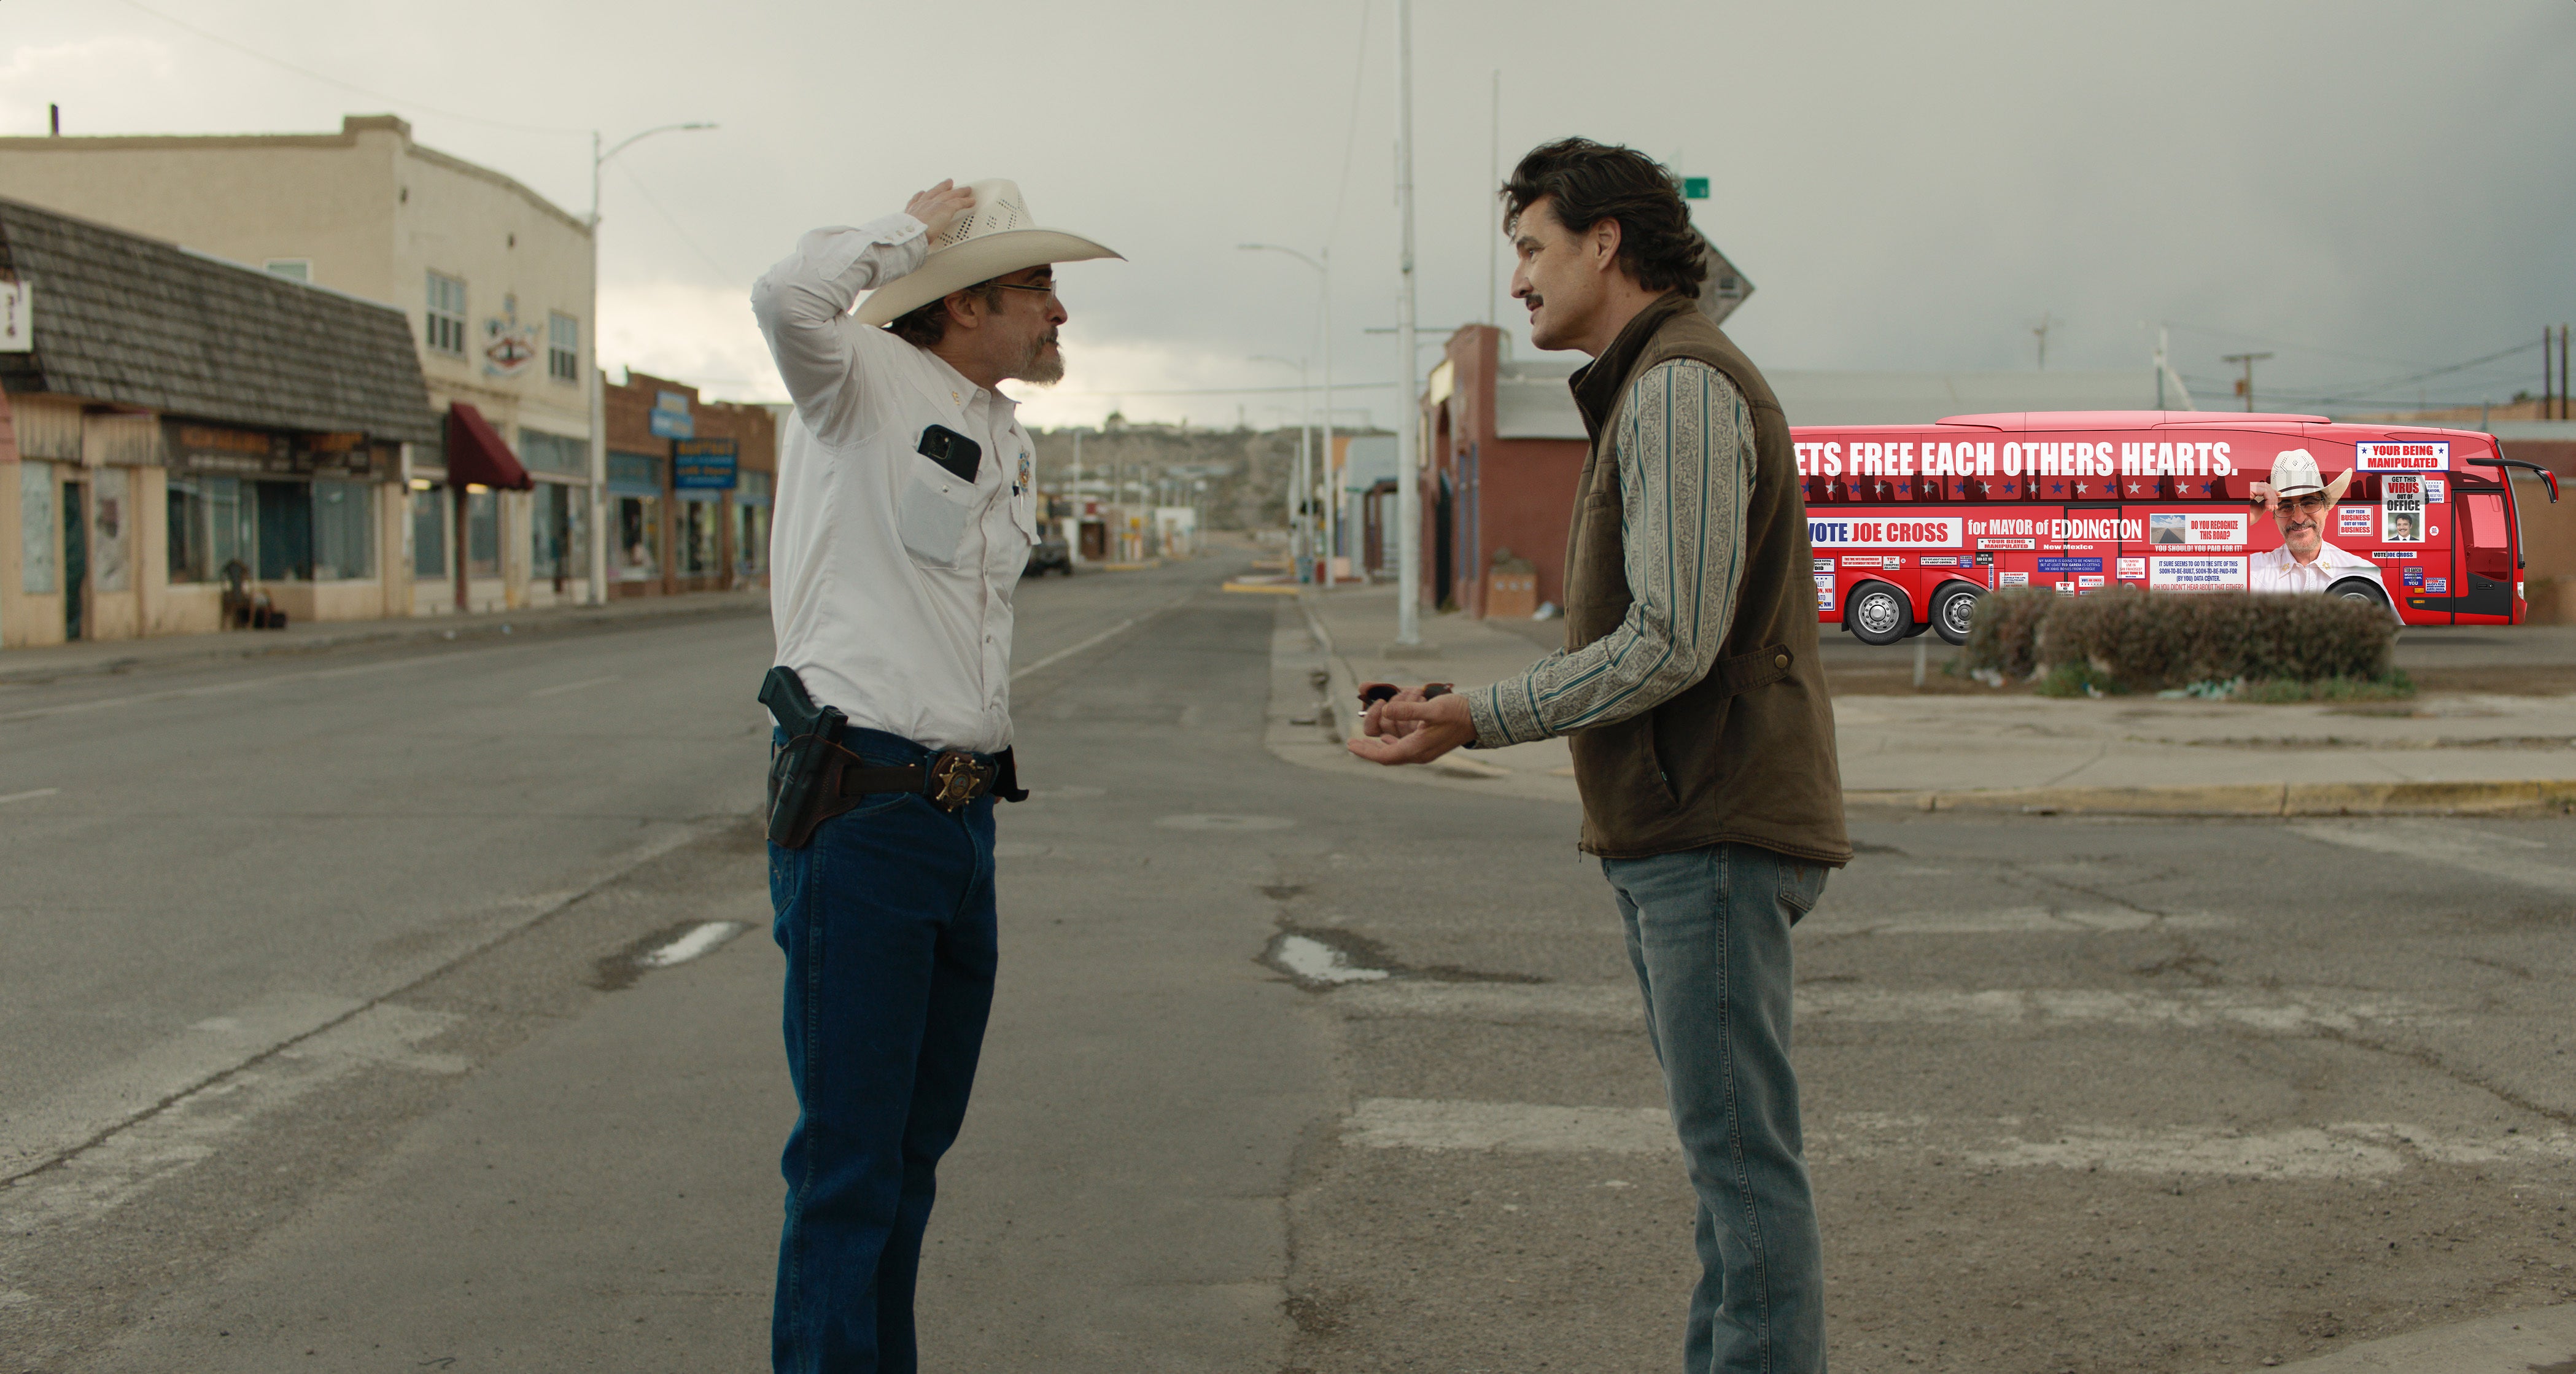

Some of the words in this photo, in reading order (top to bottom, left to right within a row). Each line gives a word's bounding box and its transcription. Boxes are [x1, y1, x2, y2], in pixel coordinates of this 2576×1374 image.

[2373, 446, 2400, 455] YOUR
[2403, 446, 2433, 455] BEING
[1793, 442, 1842, 476] ETS
[1850, 442, 1914, 476] FREE
[1922, 442, 1994, 476] EACH
[2003, 442, 2114, 476] OTHERS
[2122, 442, 2238, 476] HEARTS.
[2368, 458, 2437, 468] MANIPULATED
[2388, 483, 2419, 493] VIRUS
[2387, 500, 2420, 511] OFFICE
[1968, 519, 1987, 535] for
[1990, 519, 2033, 535] MAYOR
[2036, 519, 2049, 535] of
[2052, 519, 2142, 539] EDDINGTON
[2191, 521, 2198, 529] DO
[2200, 521, 2209, 529] YOU
[2211, 521, 2238, 529] RECOGNIZE
[1852, 523, 1882, 542] JOE
[1887, 523, 1948, 542] CROSS
[2200, 531, 2212, 540] THIS
[2213, 531, 2230, 540] ROAD?
